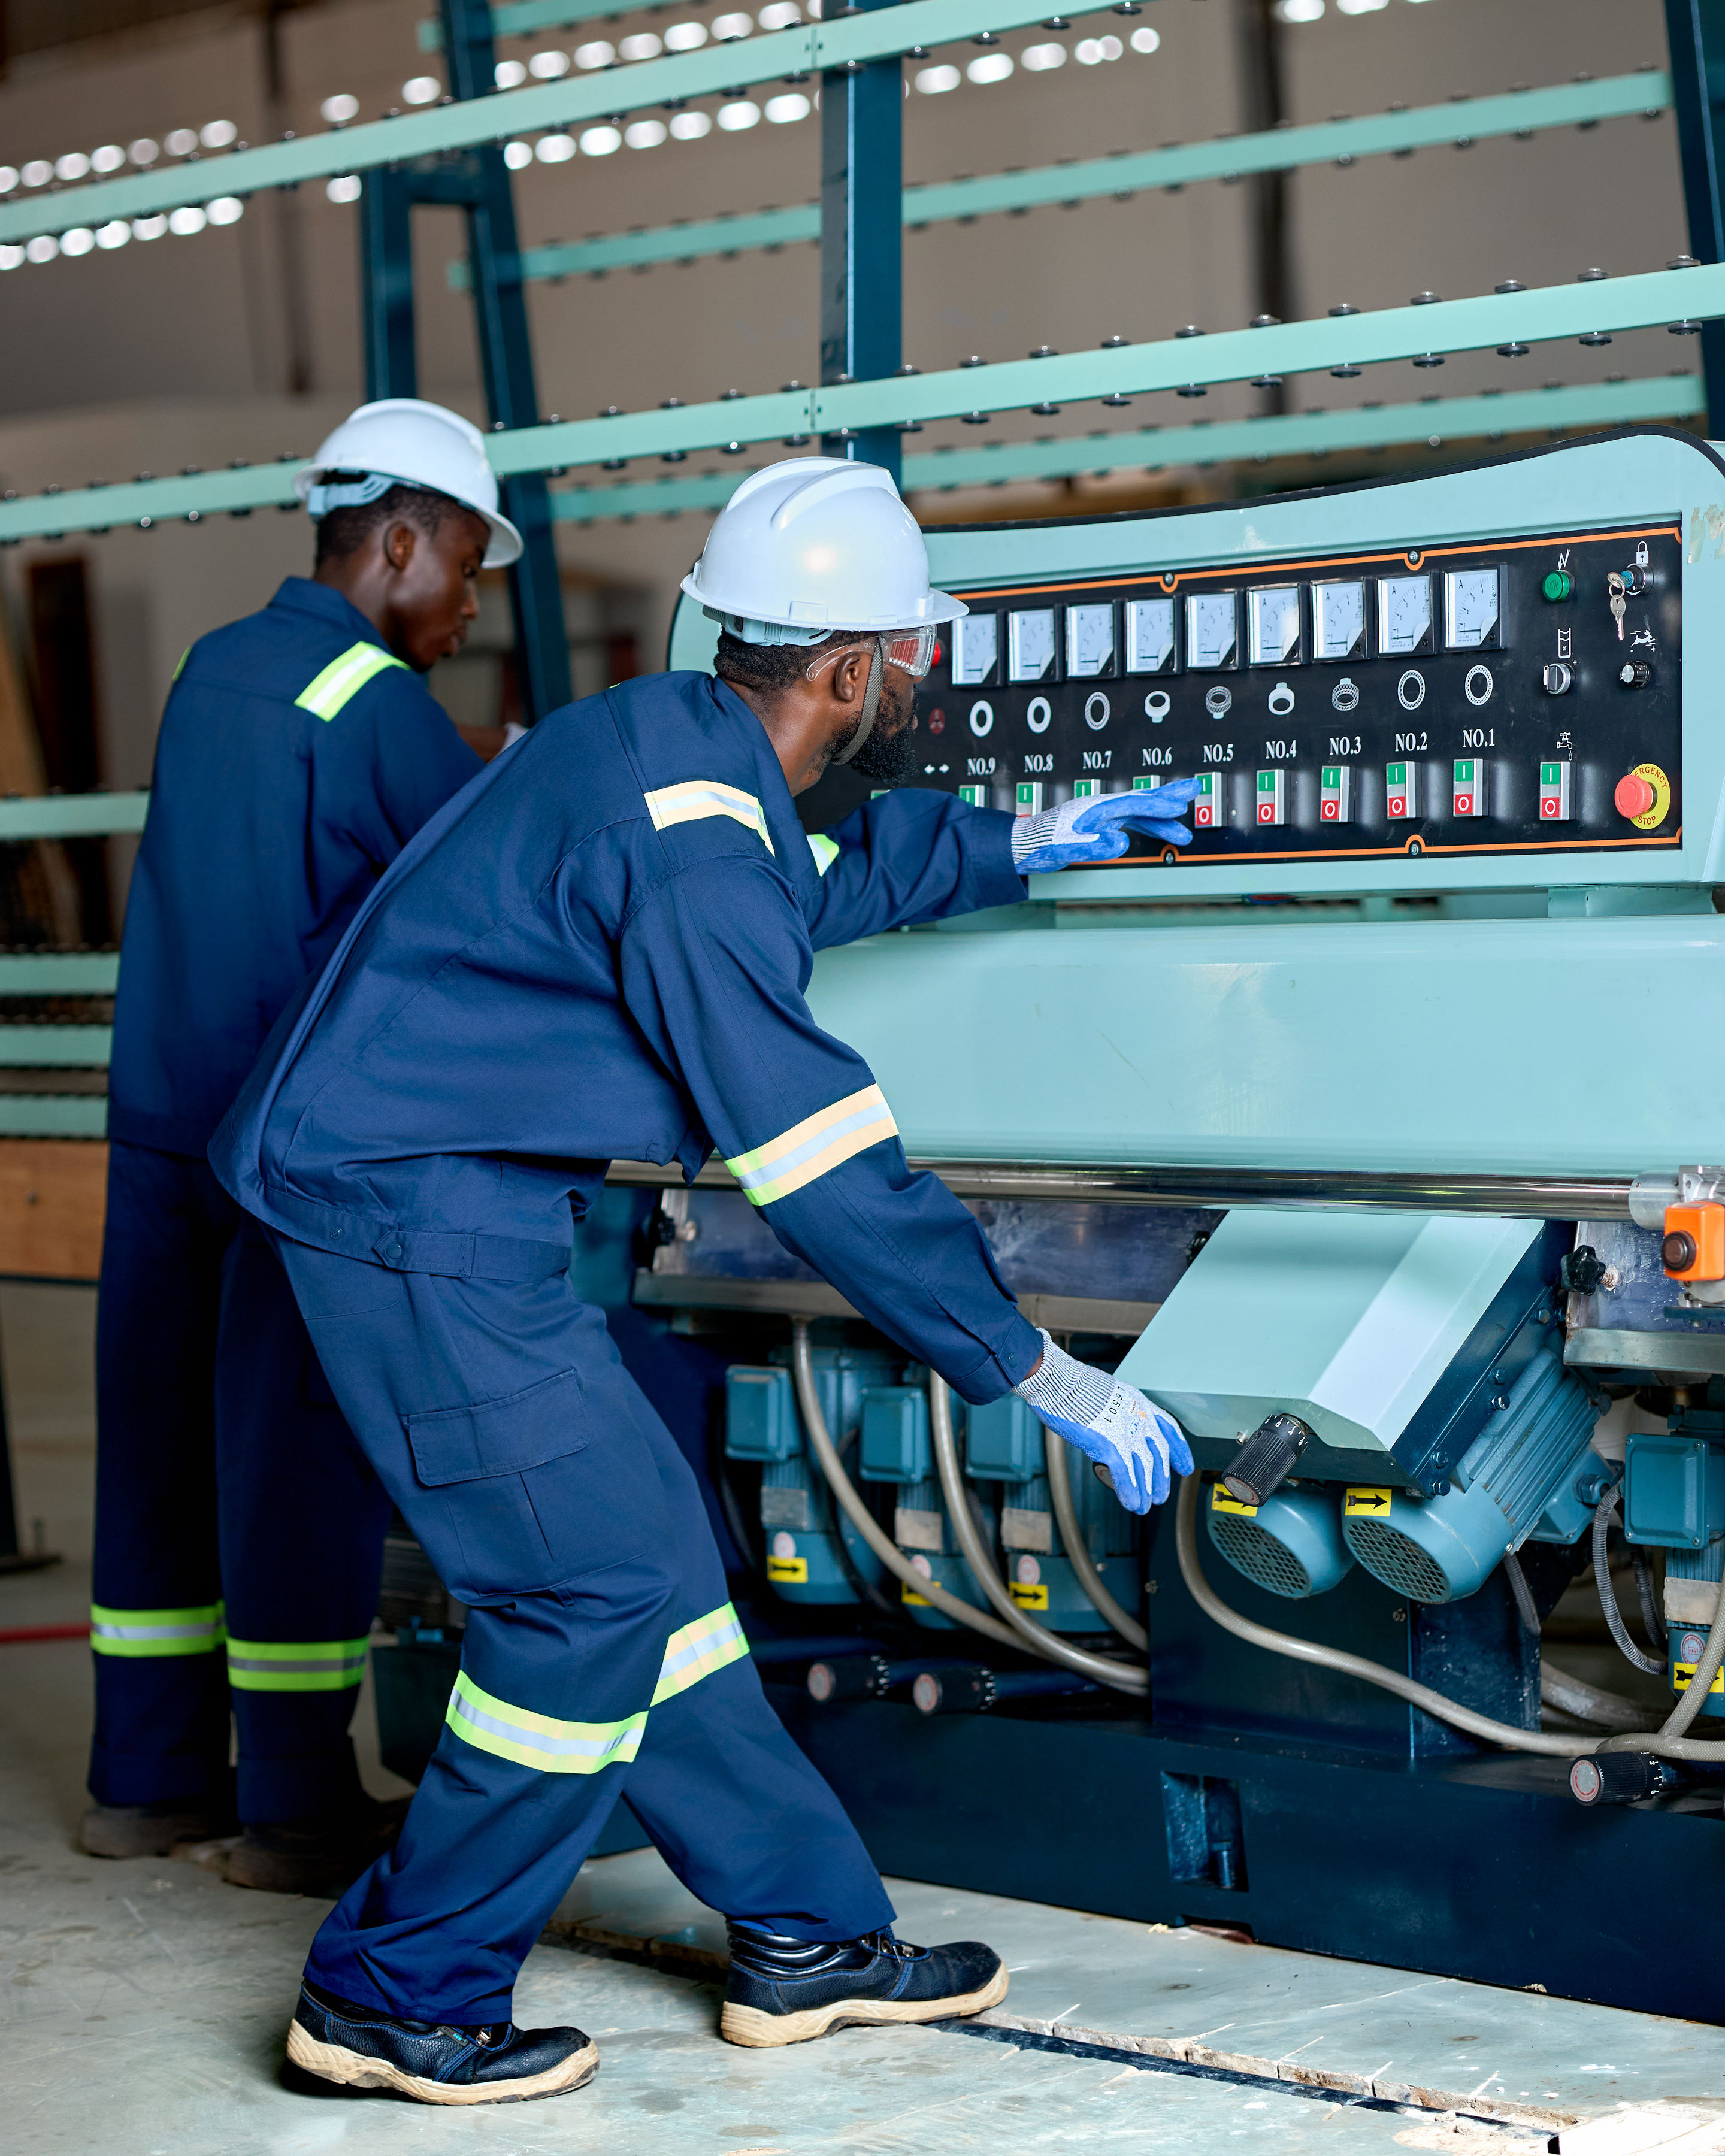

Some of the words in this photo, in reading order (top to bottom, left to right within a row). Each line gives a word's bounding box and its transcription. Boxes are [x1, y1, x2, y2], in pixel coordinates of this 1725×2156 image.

[1392, 586, 1396, 594] A
[1459, 580, 1463, 588] A
[1329, 735, 1361, 756] NO.3
[1395, 732, 1427, 752] NO.2
[1462, 728, 1495, 748] NO.1
[1142, 747, 1172, 766] NO.6
[1203, 743, 1234, 763] NO.5
[1266, 740, 1297, 759] NO.4
[967, 757, 996, 776] NO.9
[1024, 753, 1054, 773] NO.8
[1082, 750, 1112, 769] NO.7
[1634, 766, 1668, 788] ERGENCY
[1638, 815, 1656, 825] STOP
[1104, 1386, 1126, 1423] L6501
